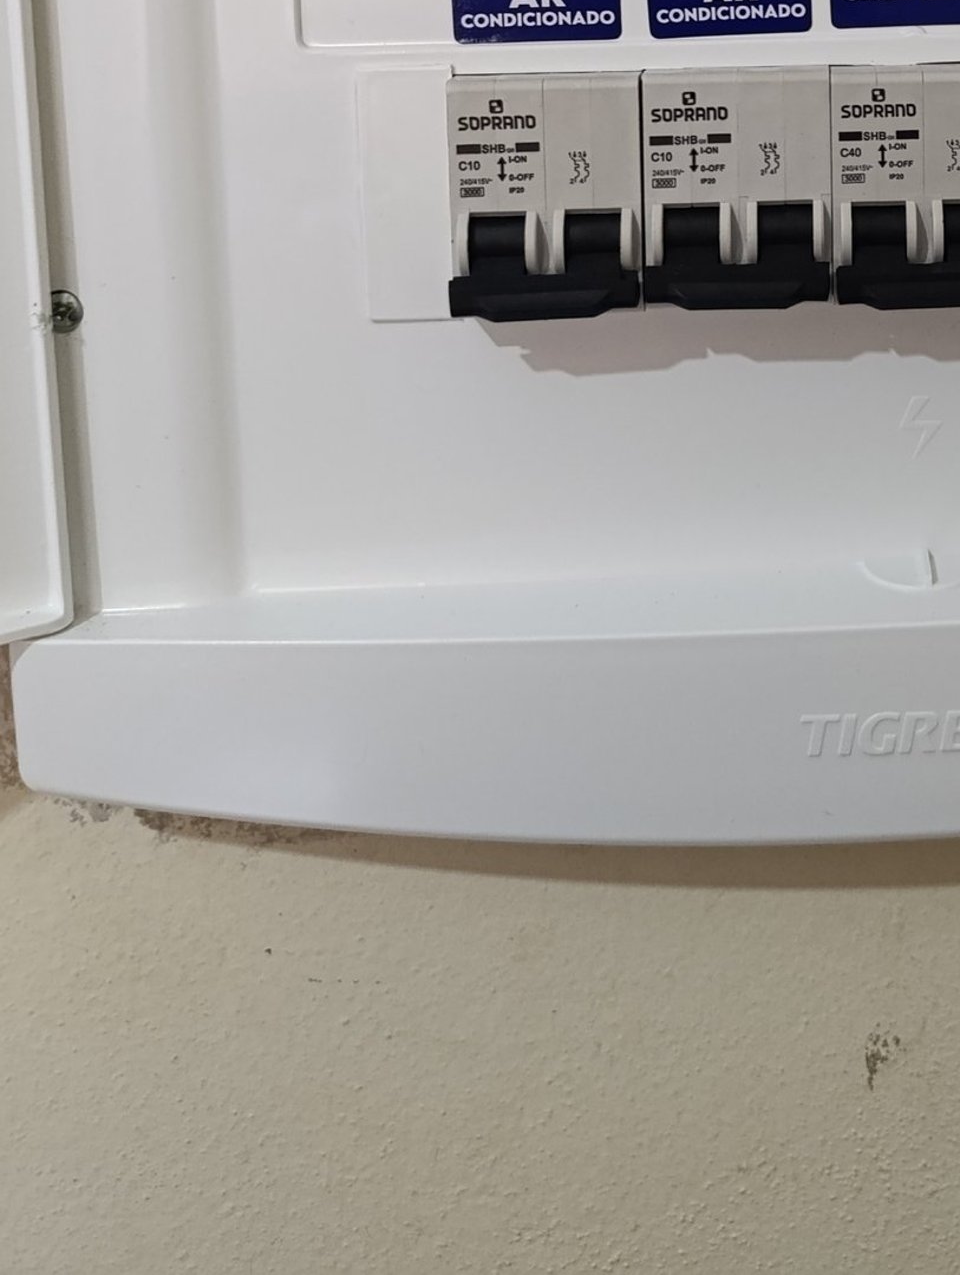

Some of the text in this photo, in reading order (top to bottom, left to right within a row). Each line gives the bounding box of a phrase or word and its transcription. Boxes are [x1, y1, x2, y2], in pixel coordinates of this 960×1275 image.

[460, 10, 615, 29] CONDICIONADO
[656, 3, 806, 24] CONDICIONADO
[651, 106, 728, 122] SOPRANO
[841, 104, 916, 118] SOPRANO
[458, 115, 536, 131] SOPRANO
[651, 152, 672, 162] C10
[840, 147, 861, 157] C40
[458, 160, 481, 171] C10
